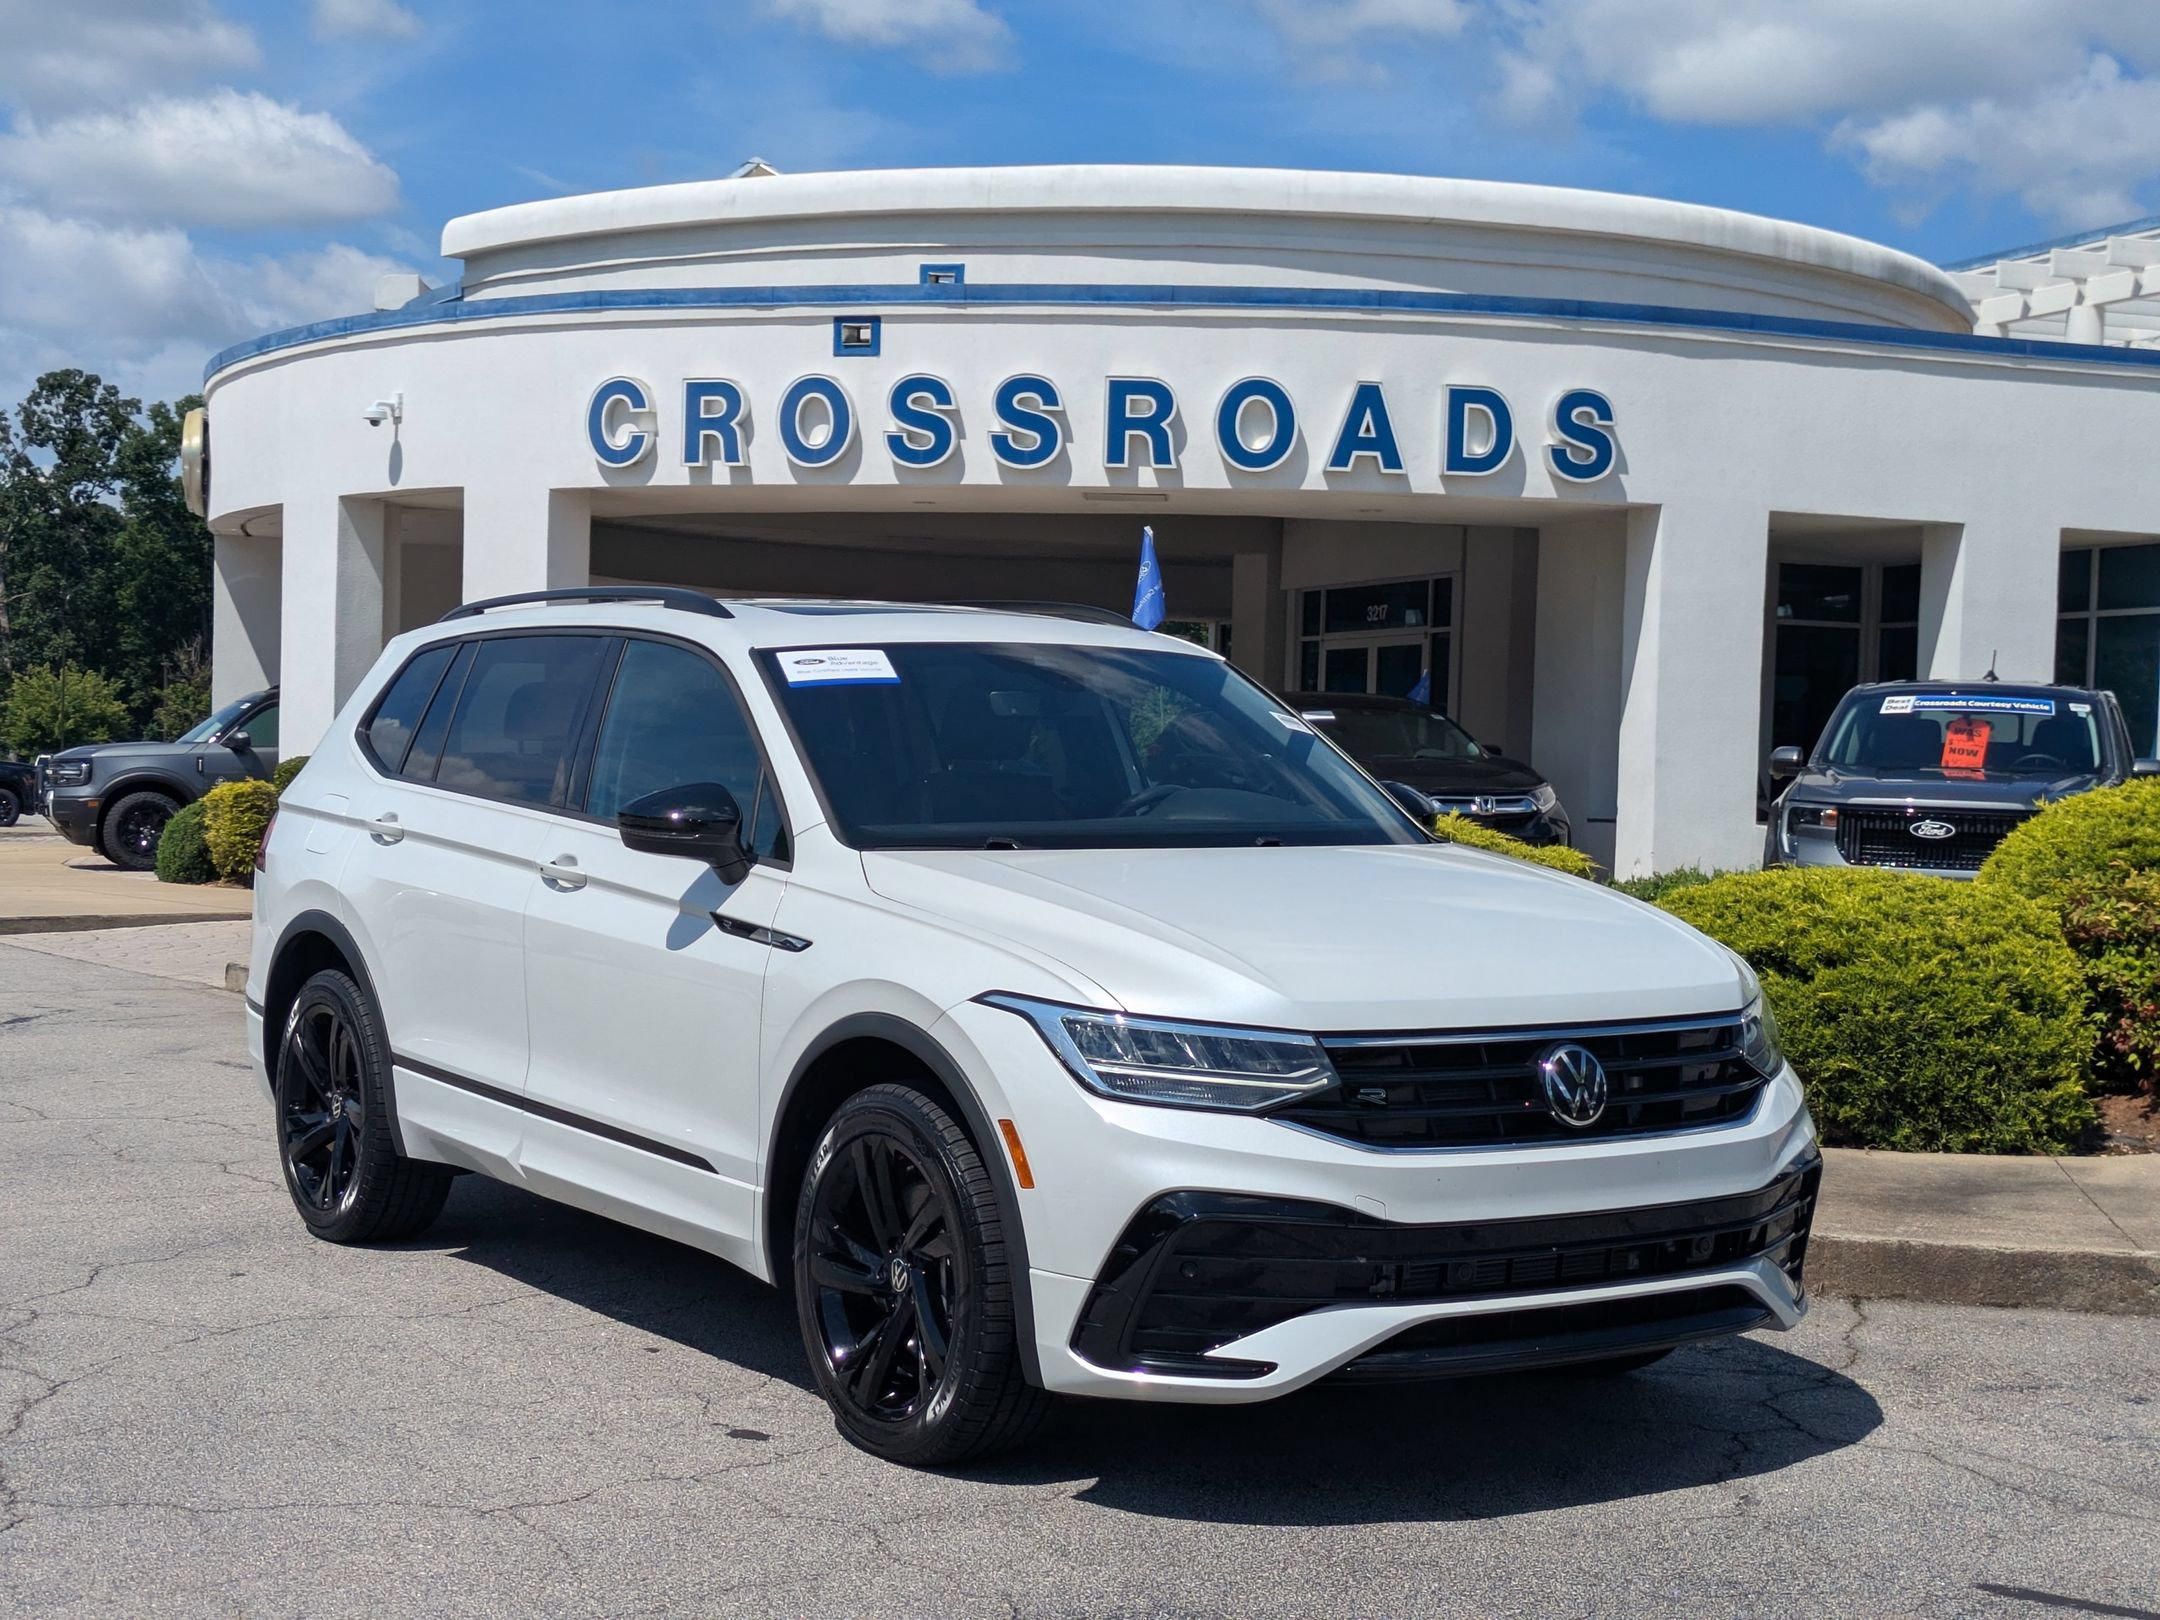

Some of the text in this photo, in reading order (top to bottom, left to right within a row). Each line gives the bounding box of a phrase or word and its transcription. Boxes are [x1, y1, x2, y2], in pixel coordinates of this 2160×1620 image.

[586, 373, 1618, 482] CROSSROADS
[1366, 604, 1389, 622] 3217
[1967, 701, 2013, 709] Courtesy
[2013, 702, 2050, 711] Vehicle
[1949, 747, 1979, 757] NOW
